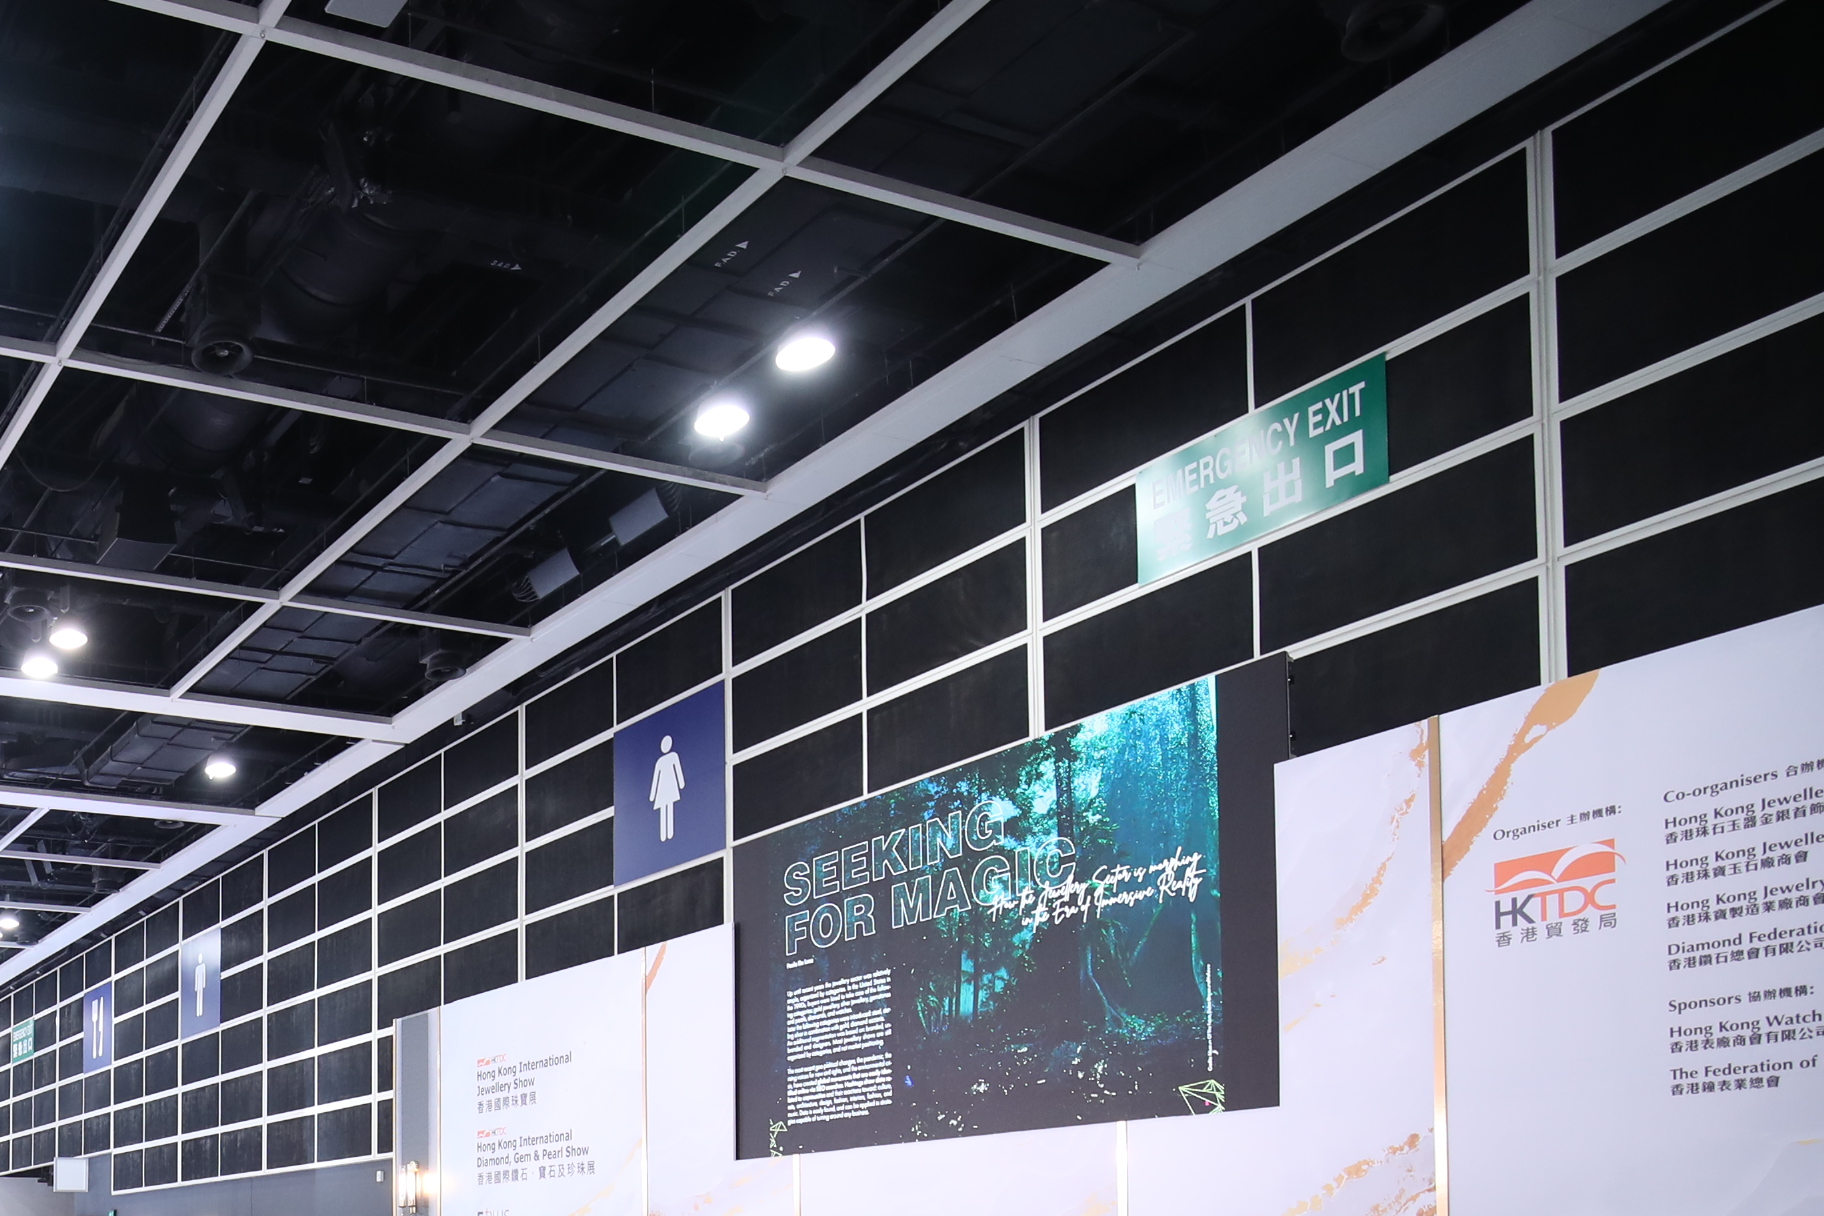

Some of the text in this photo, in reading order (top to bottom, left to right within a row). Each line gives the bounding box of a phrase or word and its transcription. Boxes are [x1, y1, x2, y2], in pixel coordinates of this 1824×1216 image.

[1152, 381, 1366, 510] EMERGENCY EXIT
[1153, 428, 1365, 562] 緊急出口
[1663, 770, 1778, 803] Co-organisers
[1492, 817, 1562, 842] Organiser
[1664, 812, 1708, 830] Hong
[1713, 803, 1756, 820] Kong
[784, 800, 1005, 907] SEEKING
[1665, 855, 1709, 872] Hong
[1714, 846, 1757, 863] Kong
[785, 836, 1076, 957] FOR MAGIC
[987, 846, 1204, 922] How the Jewellery Sector is morphing
[1021, 867, 1206, 933] in the Era of Immersive Reality
[1494, 878, 1617, 930] HKTDC
[1666, 898, 1711, 914] Hong
[1715, 889, 1758, 906] Kong
[1496, 912, 1618, 949] 香港貿發局
[1667, 933, 1743, 956] Diamond
[1668, 993, 1742, 1015] Sponsors
[1669, 1009, 1823, 1039] Hong Kong Watch
[476, 1051, 572, 1082] Hong Kong International
[1670, 1054, 1819, 1081] The Federation of
[477, 1076, 535, 1097] Jewellery Show
[477, 1091, 537, 1114] 香港國際珠寶展
[476, 1129, 573, 1153] Hong Kong International
[477, 1145, 590, 1168] Diamond, Gem & Pearl Show
